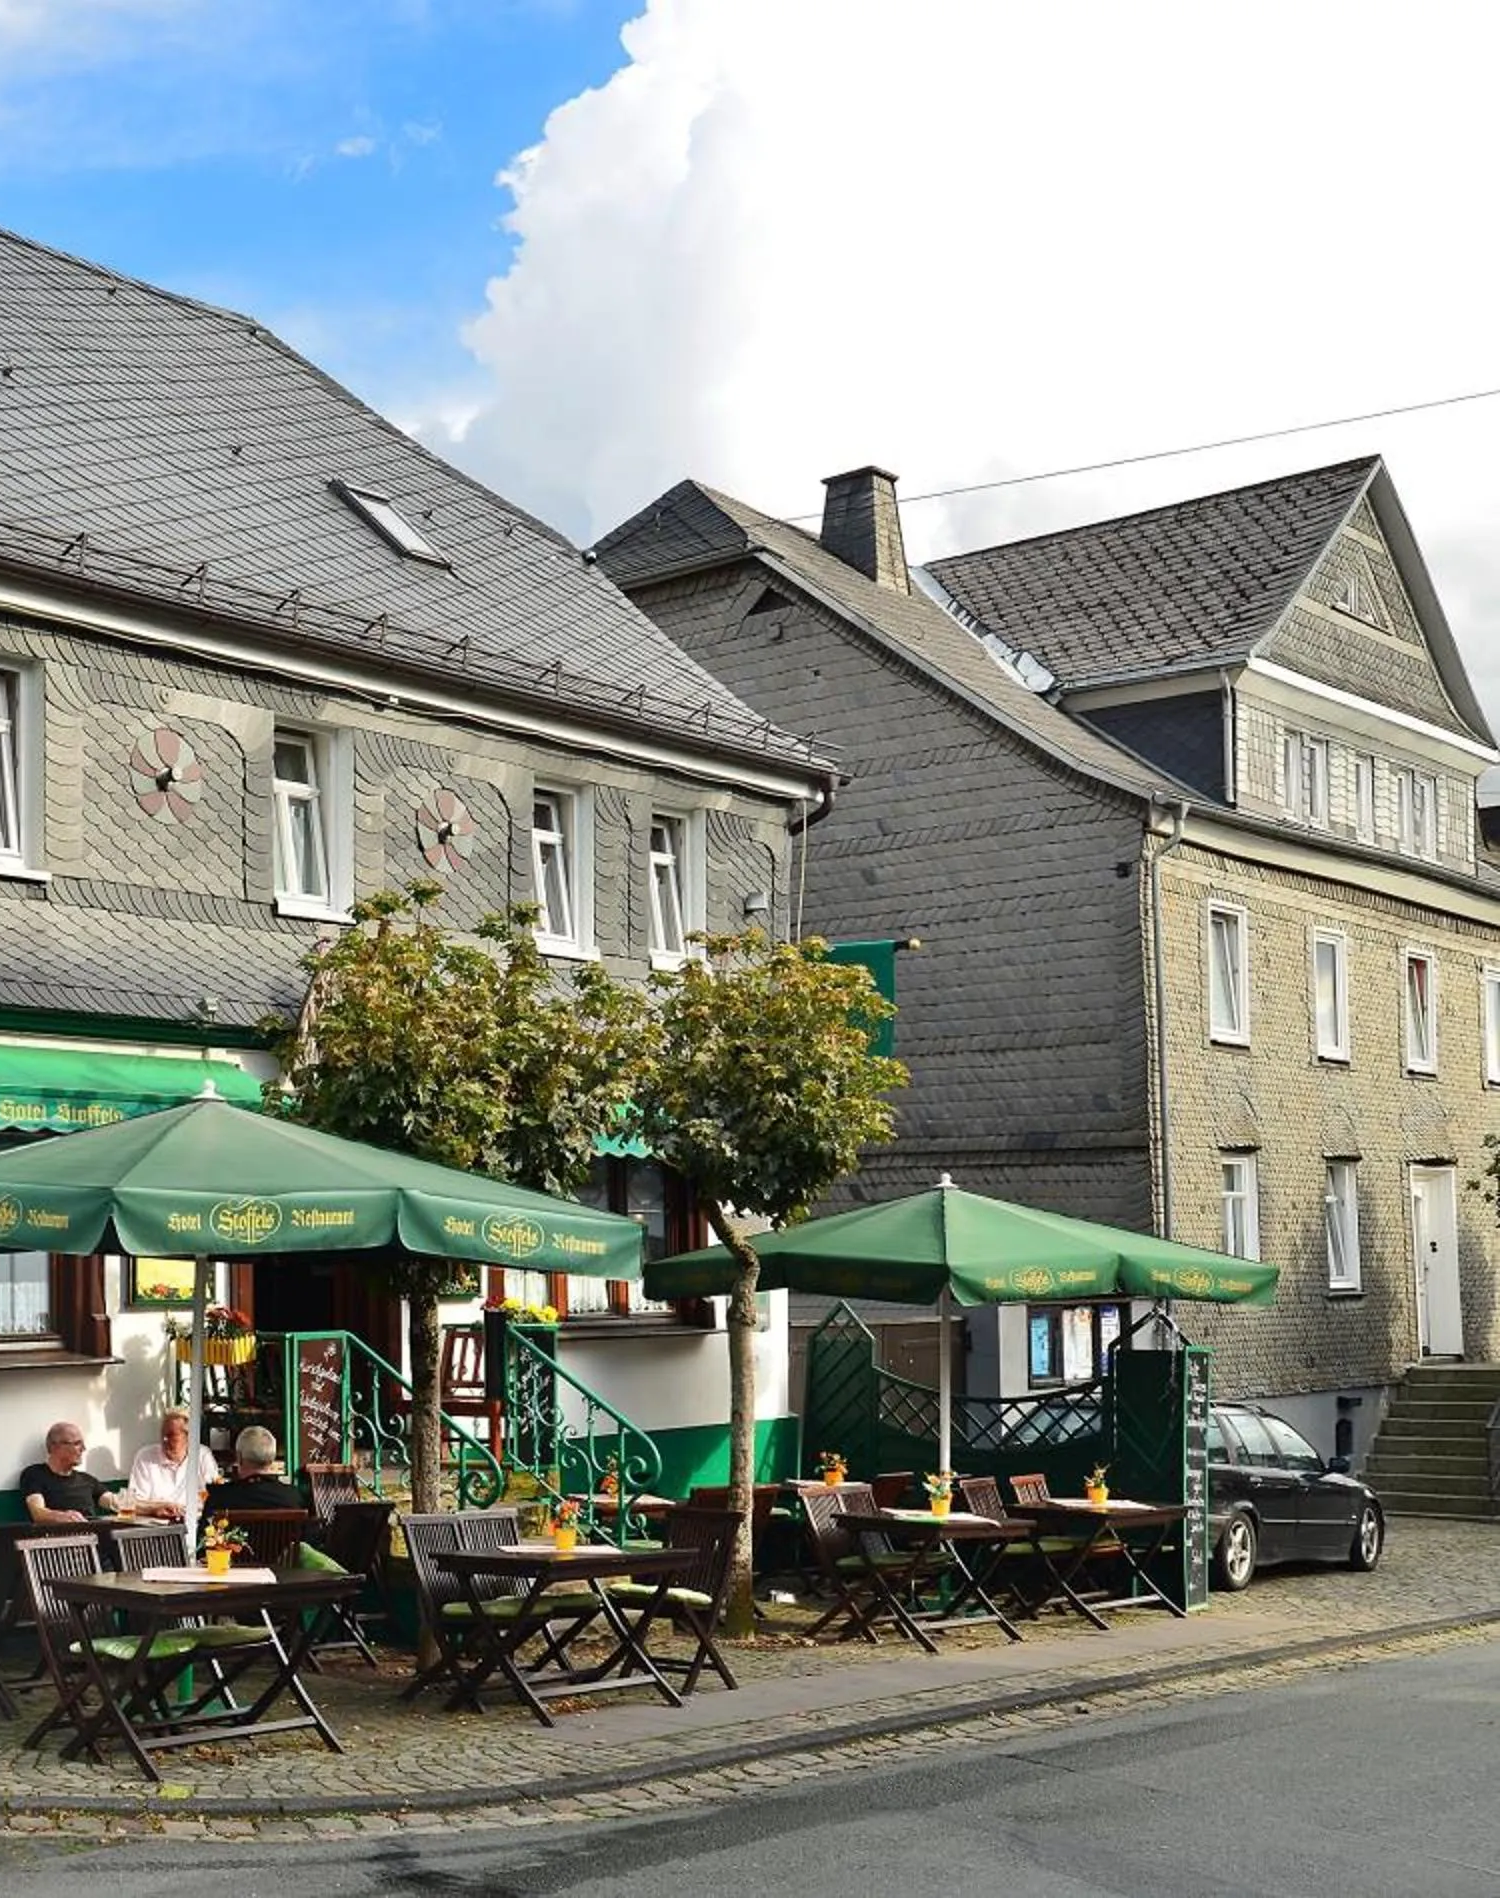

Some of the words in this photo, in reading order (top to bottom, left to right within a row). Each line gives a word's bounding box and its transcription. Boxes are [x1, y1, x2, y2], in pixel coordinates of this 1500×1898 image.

[167, 1212, 202, 1233] Hotel
[217, 1206, 276, 1243] Stoffels
[290, 1208, 355, 1229] Restaurant
[488, 1220, 539, 1257] Stoffels
